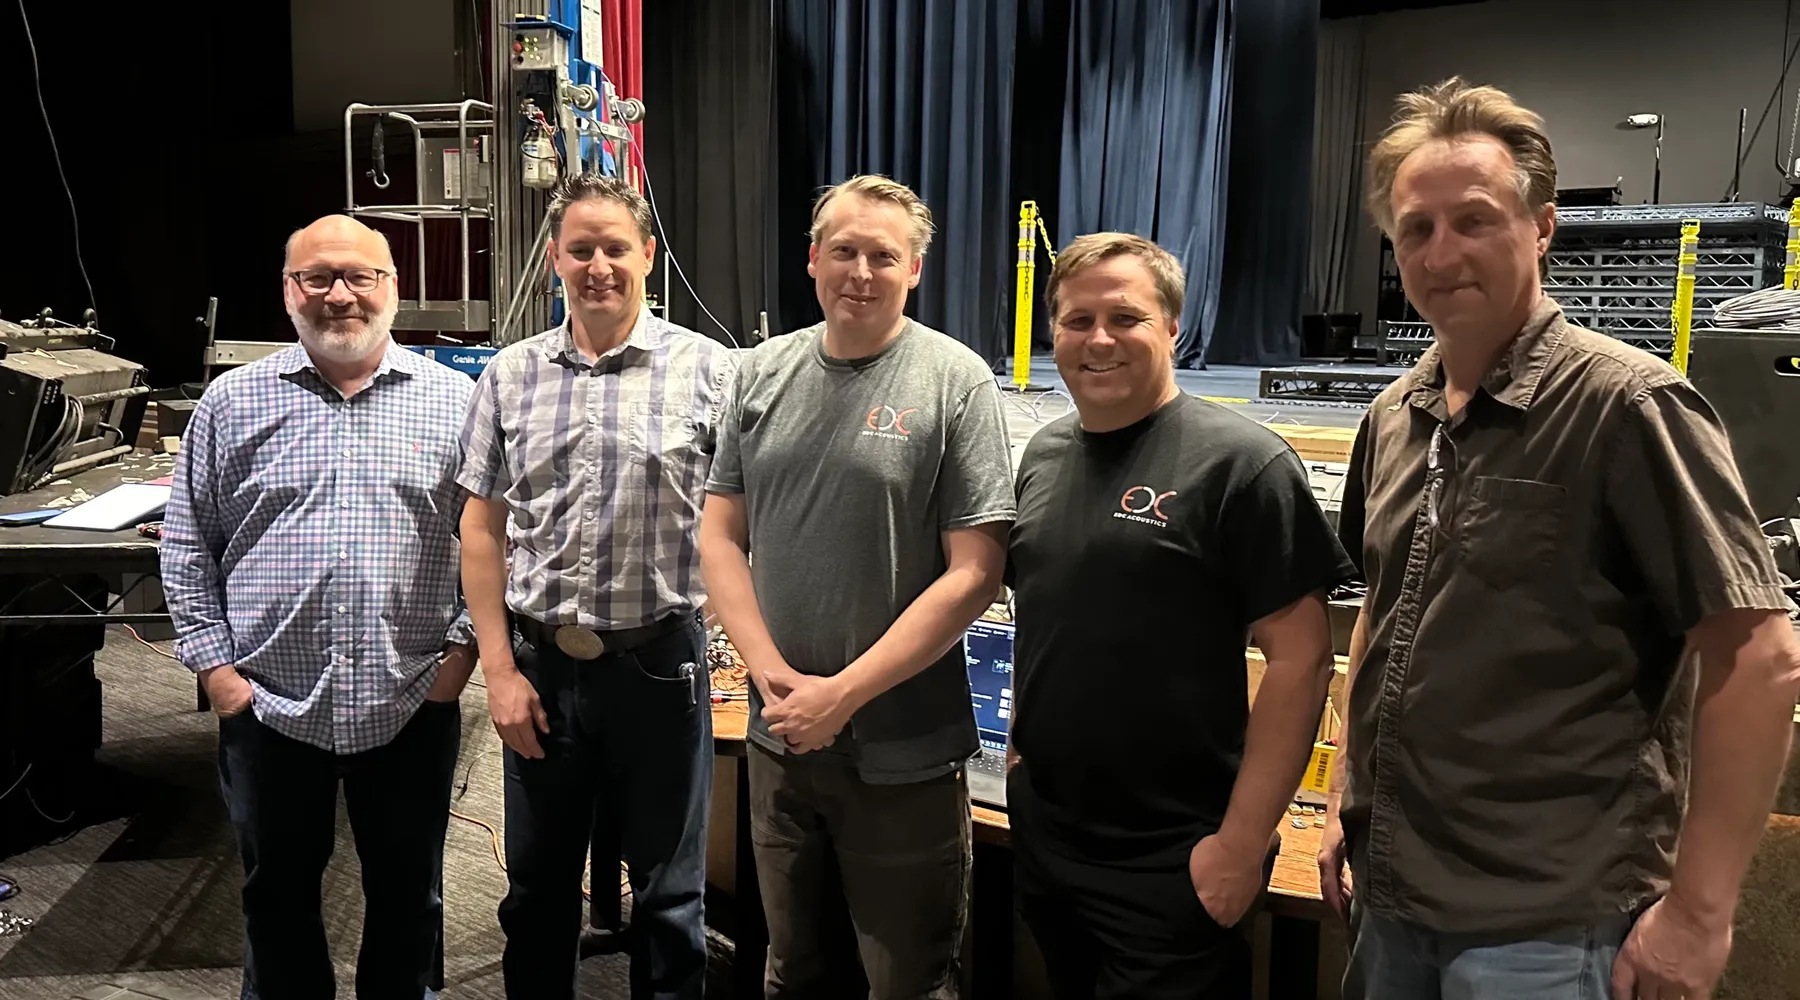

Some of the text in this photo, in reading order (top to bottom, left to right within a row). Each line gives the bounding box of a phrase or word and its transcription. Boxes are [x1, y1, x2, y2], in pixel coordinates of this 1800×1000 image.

[452, 354, 476, 364] Genie
[874, 432, 909, 441] ACOUSTICS
[1126, 514, 1167, 528] ACOUSTICS
